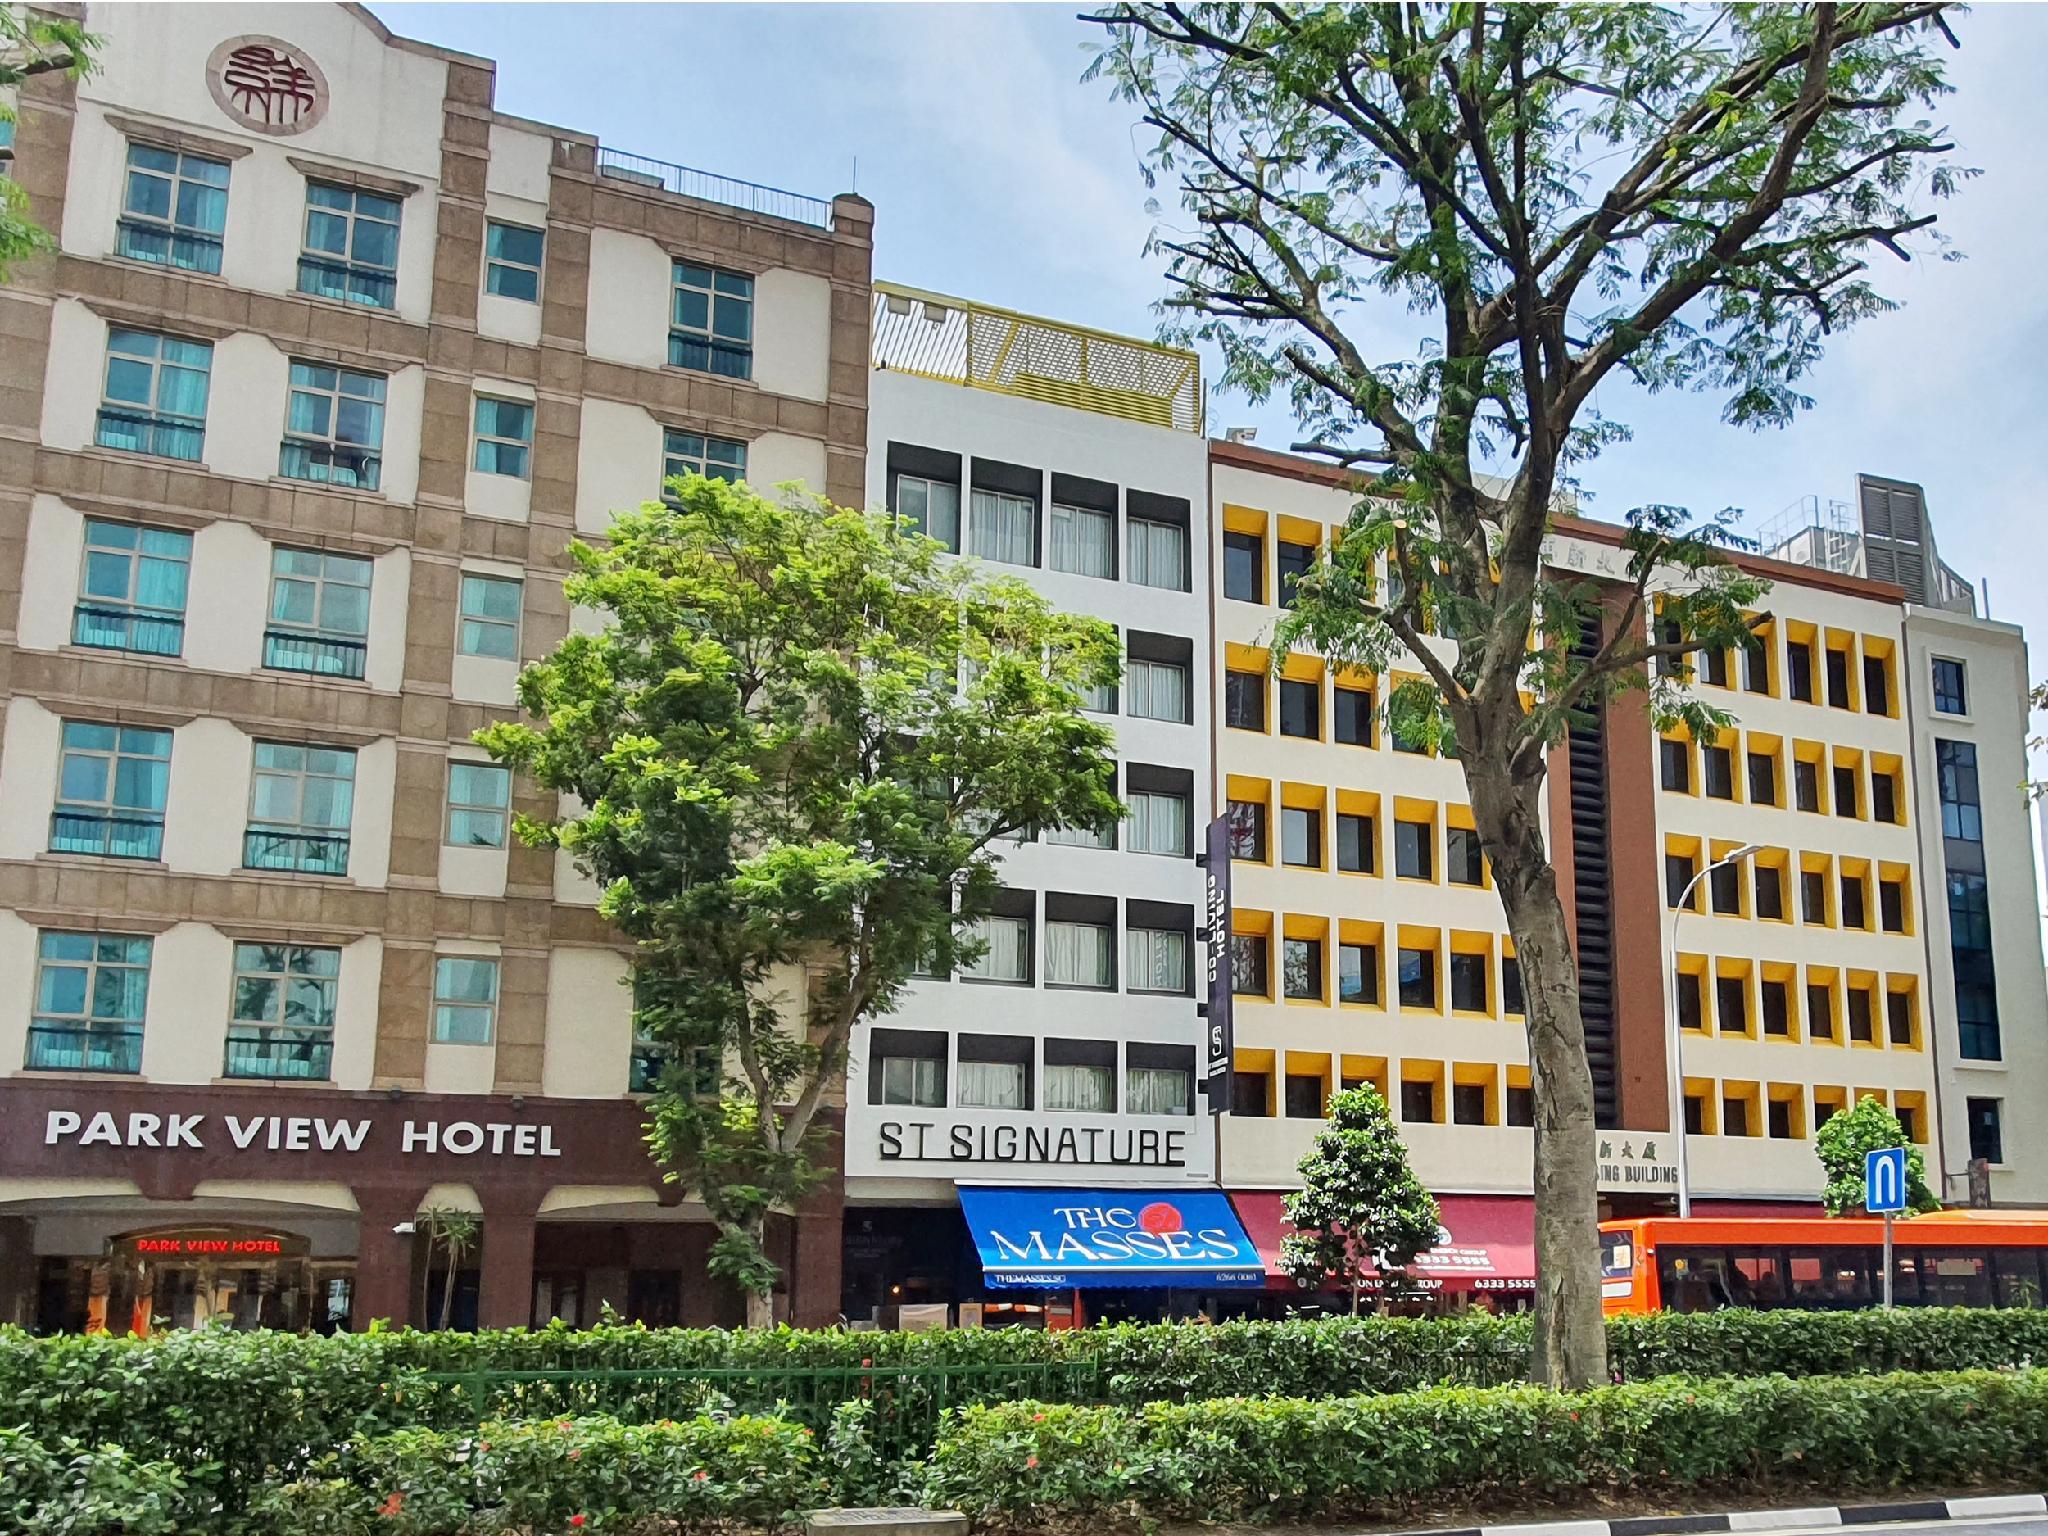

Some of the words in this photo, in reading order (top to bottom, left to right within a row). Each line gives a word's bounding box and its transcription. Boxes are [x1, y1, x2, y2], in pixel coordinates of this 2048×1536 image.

[1208, 875, 1217, 982] CO-LIVING
[1216, 889, 1226, 958] HOTEL
[45, 1111, 206, 1149] PARK
[224, 1115, 372, 1152] VIEW
[401, 1120, 562, 1157] HOTEL
[879, 1122, 935, 1160] ST
[950, 1124, 1186, 1168] SIGNATURE
[1600, 1164, 1620, 1182] ING
[1624, 1165, 1678, 1184] BUILDING
[137, 1239, 181, 1252] PARK
[187, 1240, 229, 1253] VIEW
[232, 1240, 281, 1254] HOTEL
[990, 1229, 1239, 1261] MASSES
[1474, 1279, 1505, 1289] 6333
[1507, 1279, 1537, 1289] 5555
